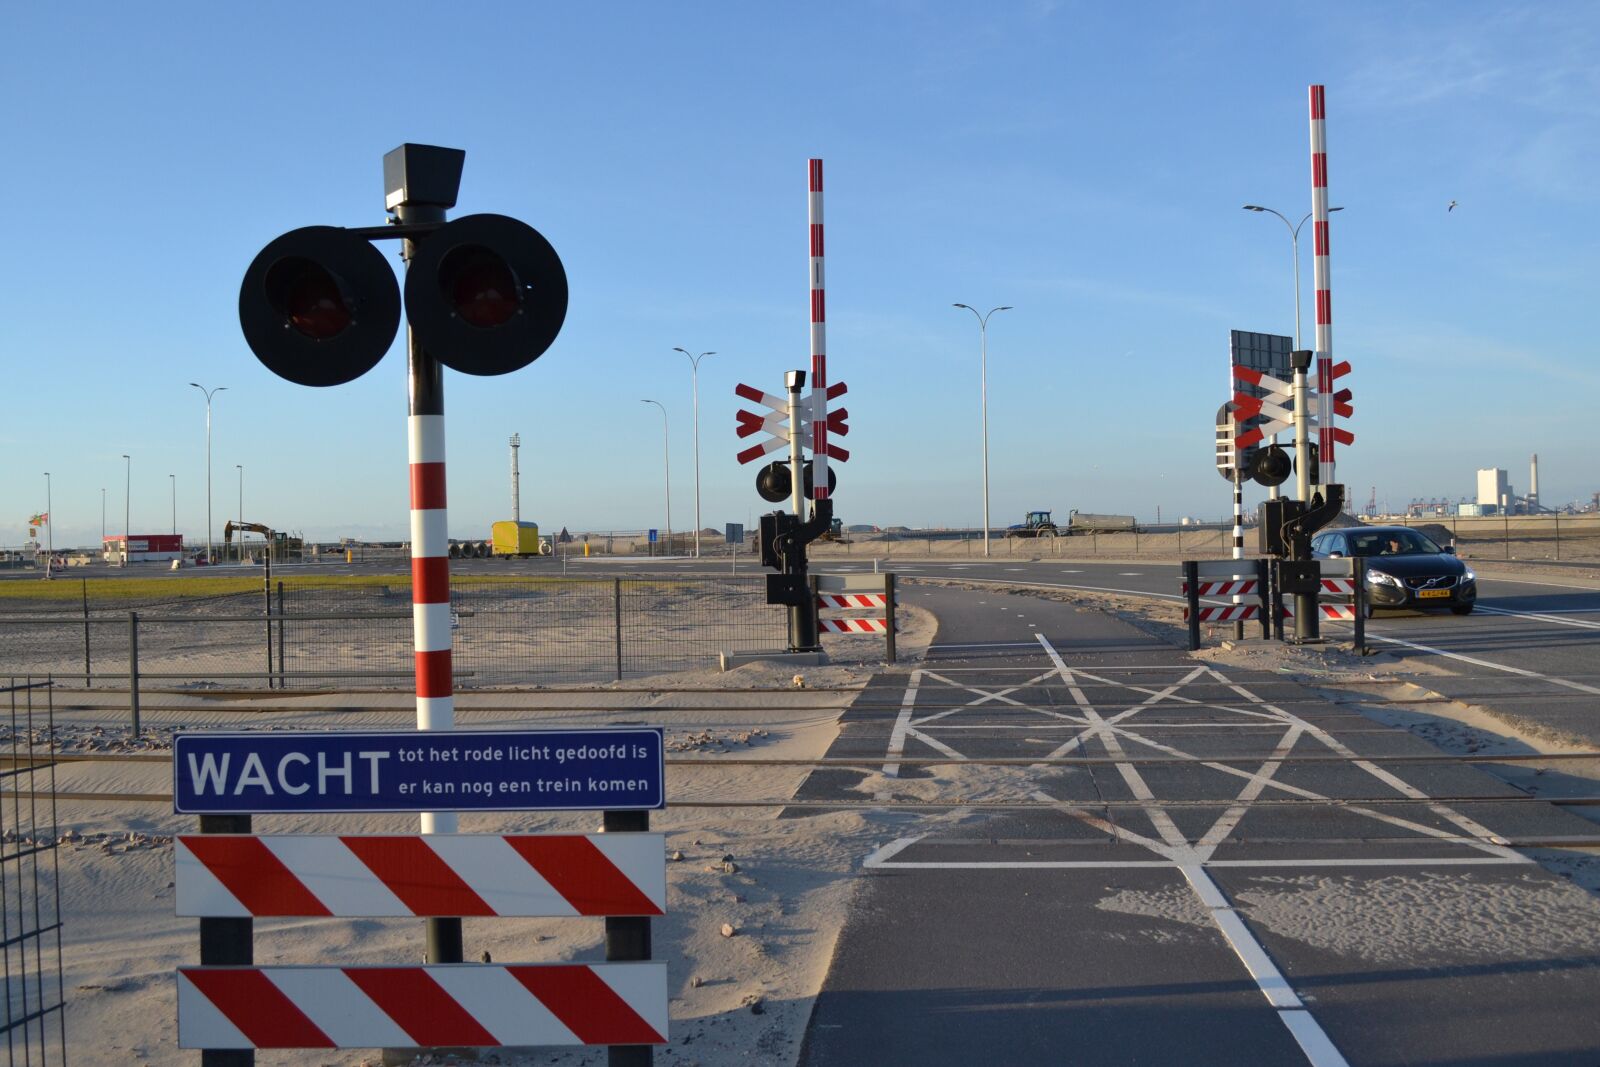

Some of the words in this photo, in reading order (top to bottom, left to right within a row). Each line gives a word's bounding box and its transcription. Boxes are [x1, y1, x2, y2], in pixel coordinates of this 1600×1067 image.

[398, 748, 424, 762] tot
[430, 747, 458, 762] het
[464, 746, 503, 761] rode
[509, 746, 550, 761] licht
[555, 745, 627, 764] gedoofd
[632, 745, 647, 759] is
[187, 752, 390, 795] WACHT
[398, 783, 417, 794] er
[423, 780, 455, 794] kan
[461, 782, 493, 797] nog
[499, 781, 531, 793] een
[536, 779, 581, 793] trein
[588, 777, 648, 792] komen
